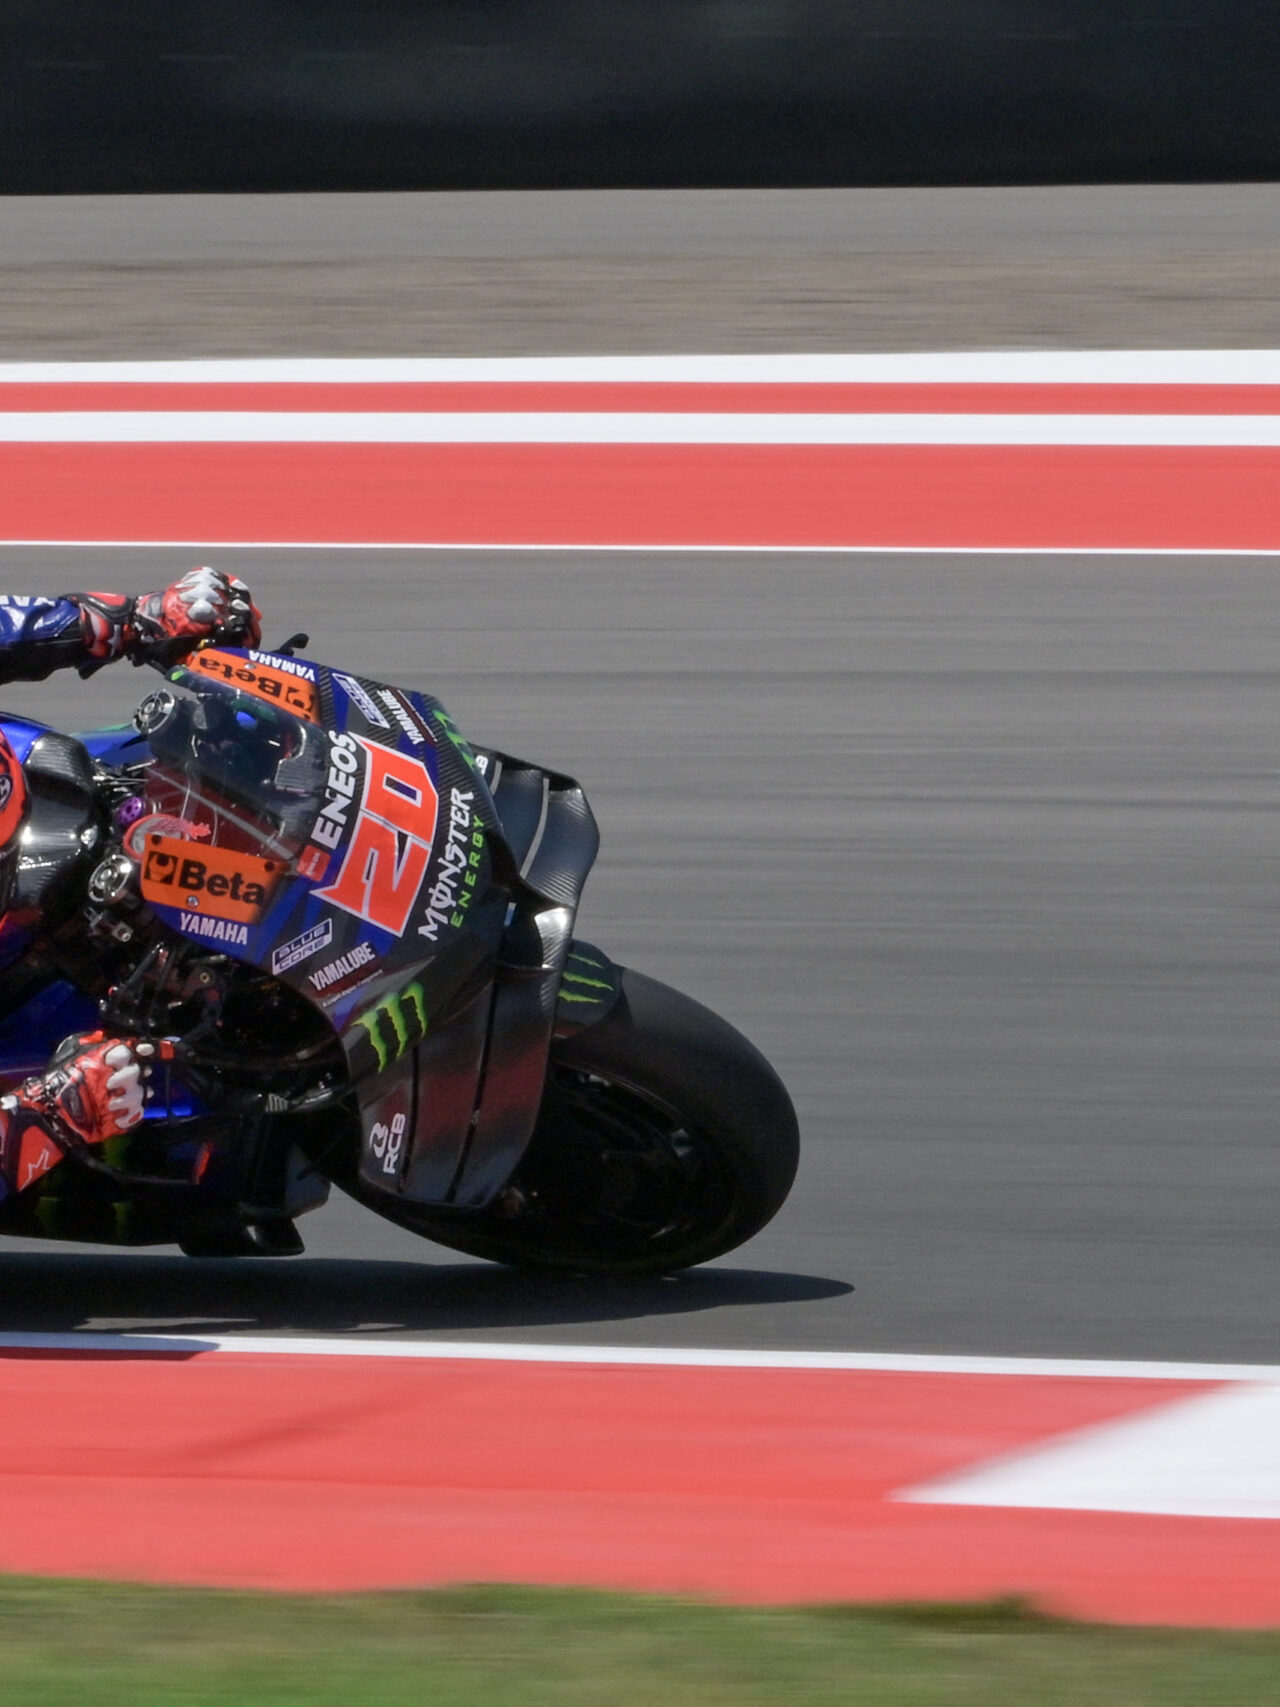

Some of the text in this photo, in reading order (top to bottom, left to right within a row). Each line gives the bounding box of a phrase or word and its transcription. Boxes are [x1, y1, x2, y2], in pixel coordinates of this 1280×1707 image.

[200, 657, 282, 698] Beta
[249, 650, 316, 682] YAMAHA
[377, 689, 425, 745] YAMALUBE
[311, 730, 358, 850] ENEOS
[309, 731, 439, 938] 20
[179, 858, 267, 904] Beta
[418, 787, 475, 942] MONSTER
[451, 814, 485, 928] ENERGY
[179, 913, 248, 945] YAMAHA
[278, 925, 326, 958] BLUE
[280, 938, 325, 969] CORE
[308, 941, 376, 991] YAMALUBE
[382, 1112, 407, 1174] RCB
